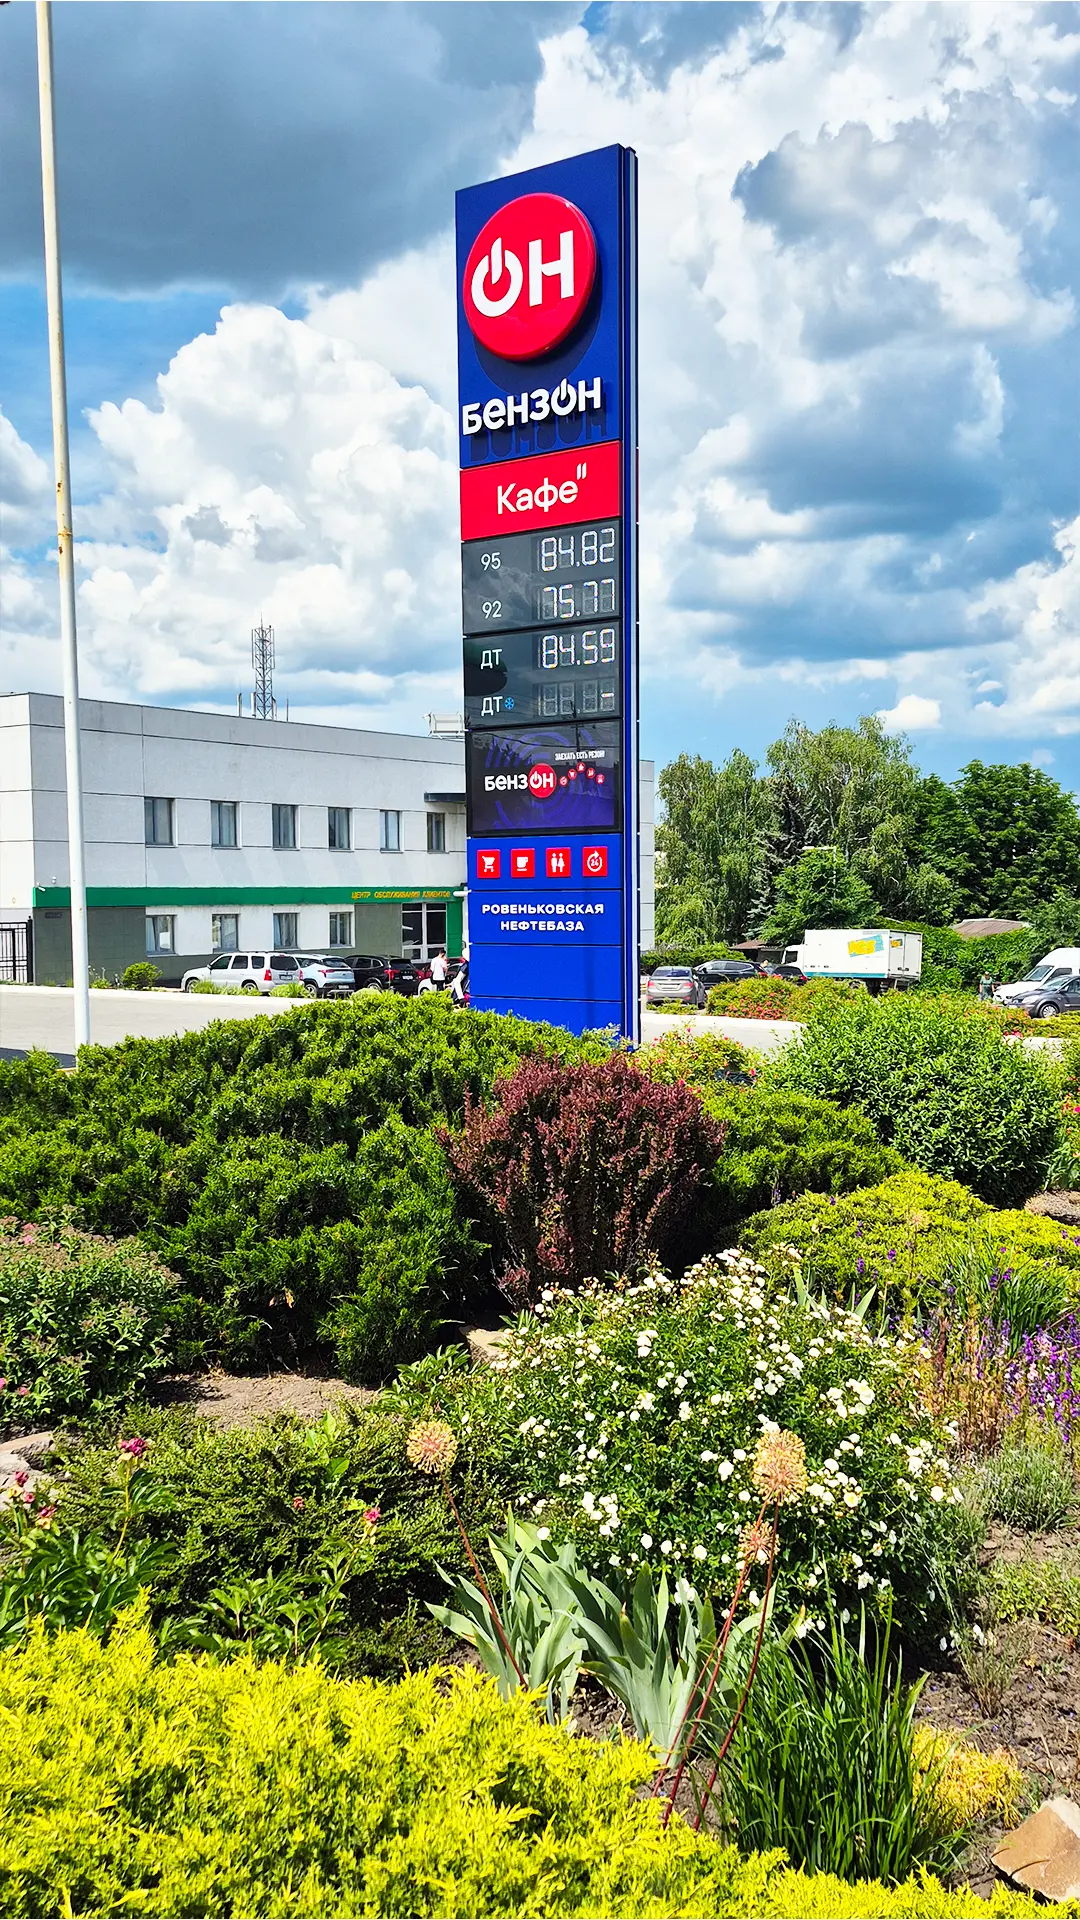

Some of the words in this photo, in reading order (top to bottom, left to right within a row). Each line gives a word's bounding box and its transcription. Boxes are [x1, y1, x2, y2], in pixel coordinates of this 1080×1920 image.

[480, 552, 502, 571] 95
[541, 527, 616, 572] 84.82
[481, 600, 503, 619] 92
[543, 578, 616, 619] 75.77
[480, 648, 503, 670] ДТ
[542, 628, 616, 669] 84.59
[481, 695, 503, 717] ДТ
[576, 751, 588, 760] ЕСТЬ
[482, 903, 605, 915] РОВЕНЬКОВСКАЯ
[500, 920, 585, 932] НЕФТЕБАЗА
